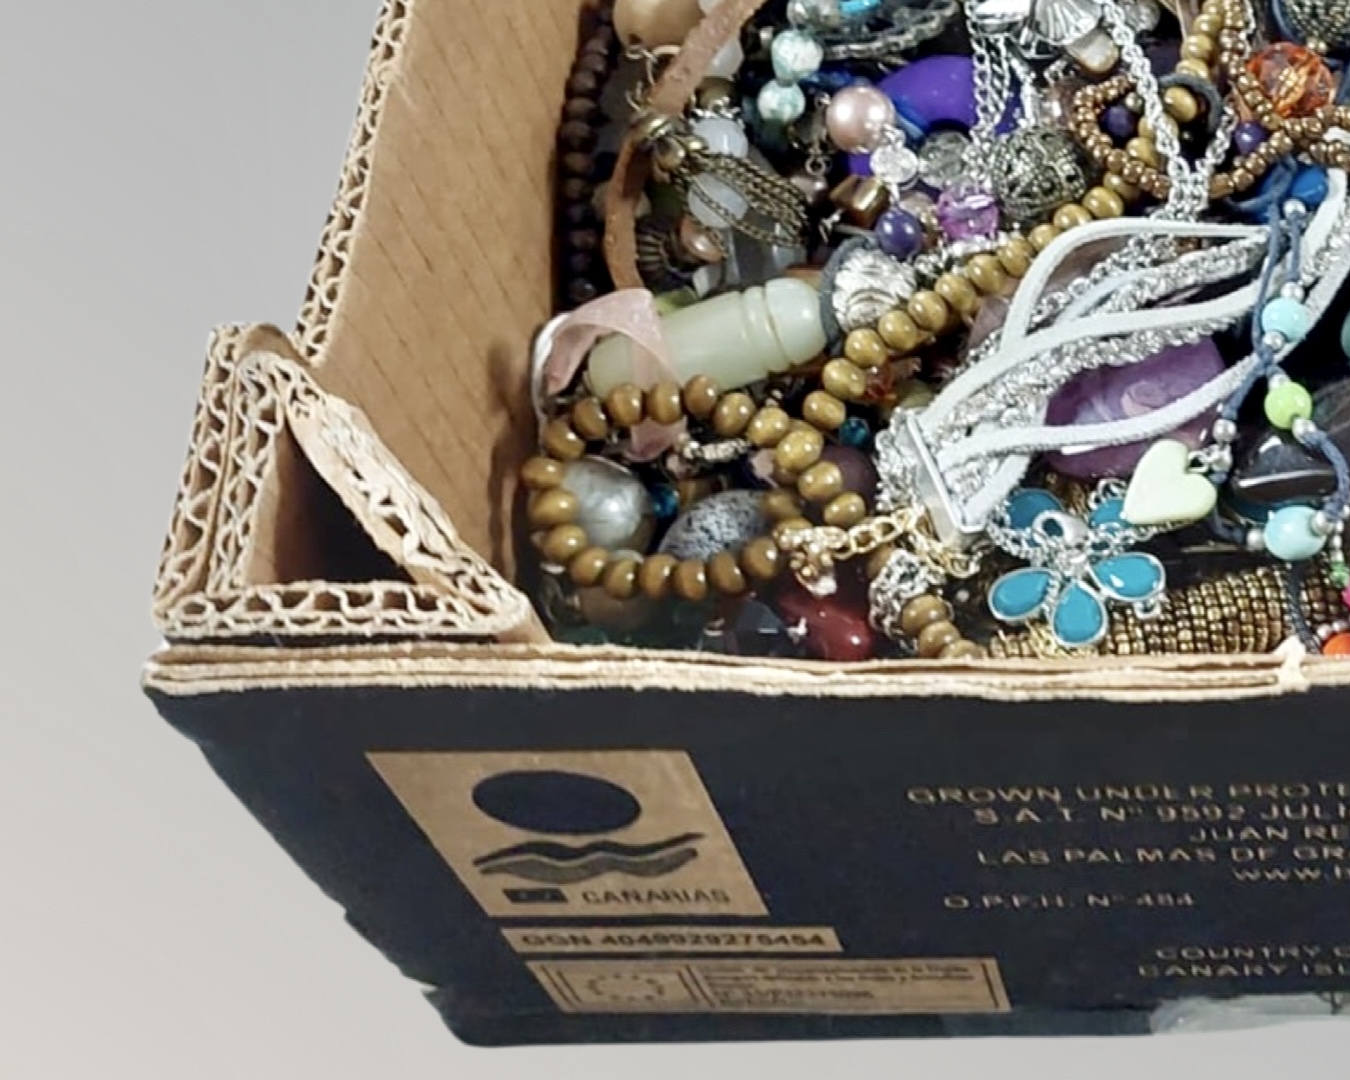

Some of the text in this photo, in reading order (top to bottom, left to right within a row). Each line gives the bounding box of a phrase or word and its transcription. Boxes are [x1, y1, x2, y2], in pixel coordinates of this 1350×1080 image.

[906, 785, 1062, 806] GROWN
[1075, 784, 1214, 801] UNDER
[1189, 824, 1289, 842] JUAN
[976, 849, 1051, 866] LAS
[1064, 846, 1217, 865] PALMAS
[580, 888, 731, 905] CANARIAS
[521, 933, 592, 947] GGN
[1155, 944, 1321, 960] COUNTRY
[1137, 963, 1287, 978] CANARY
